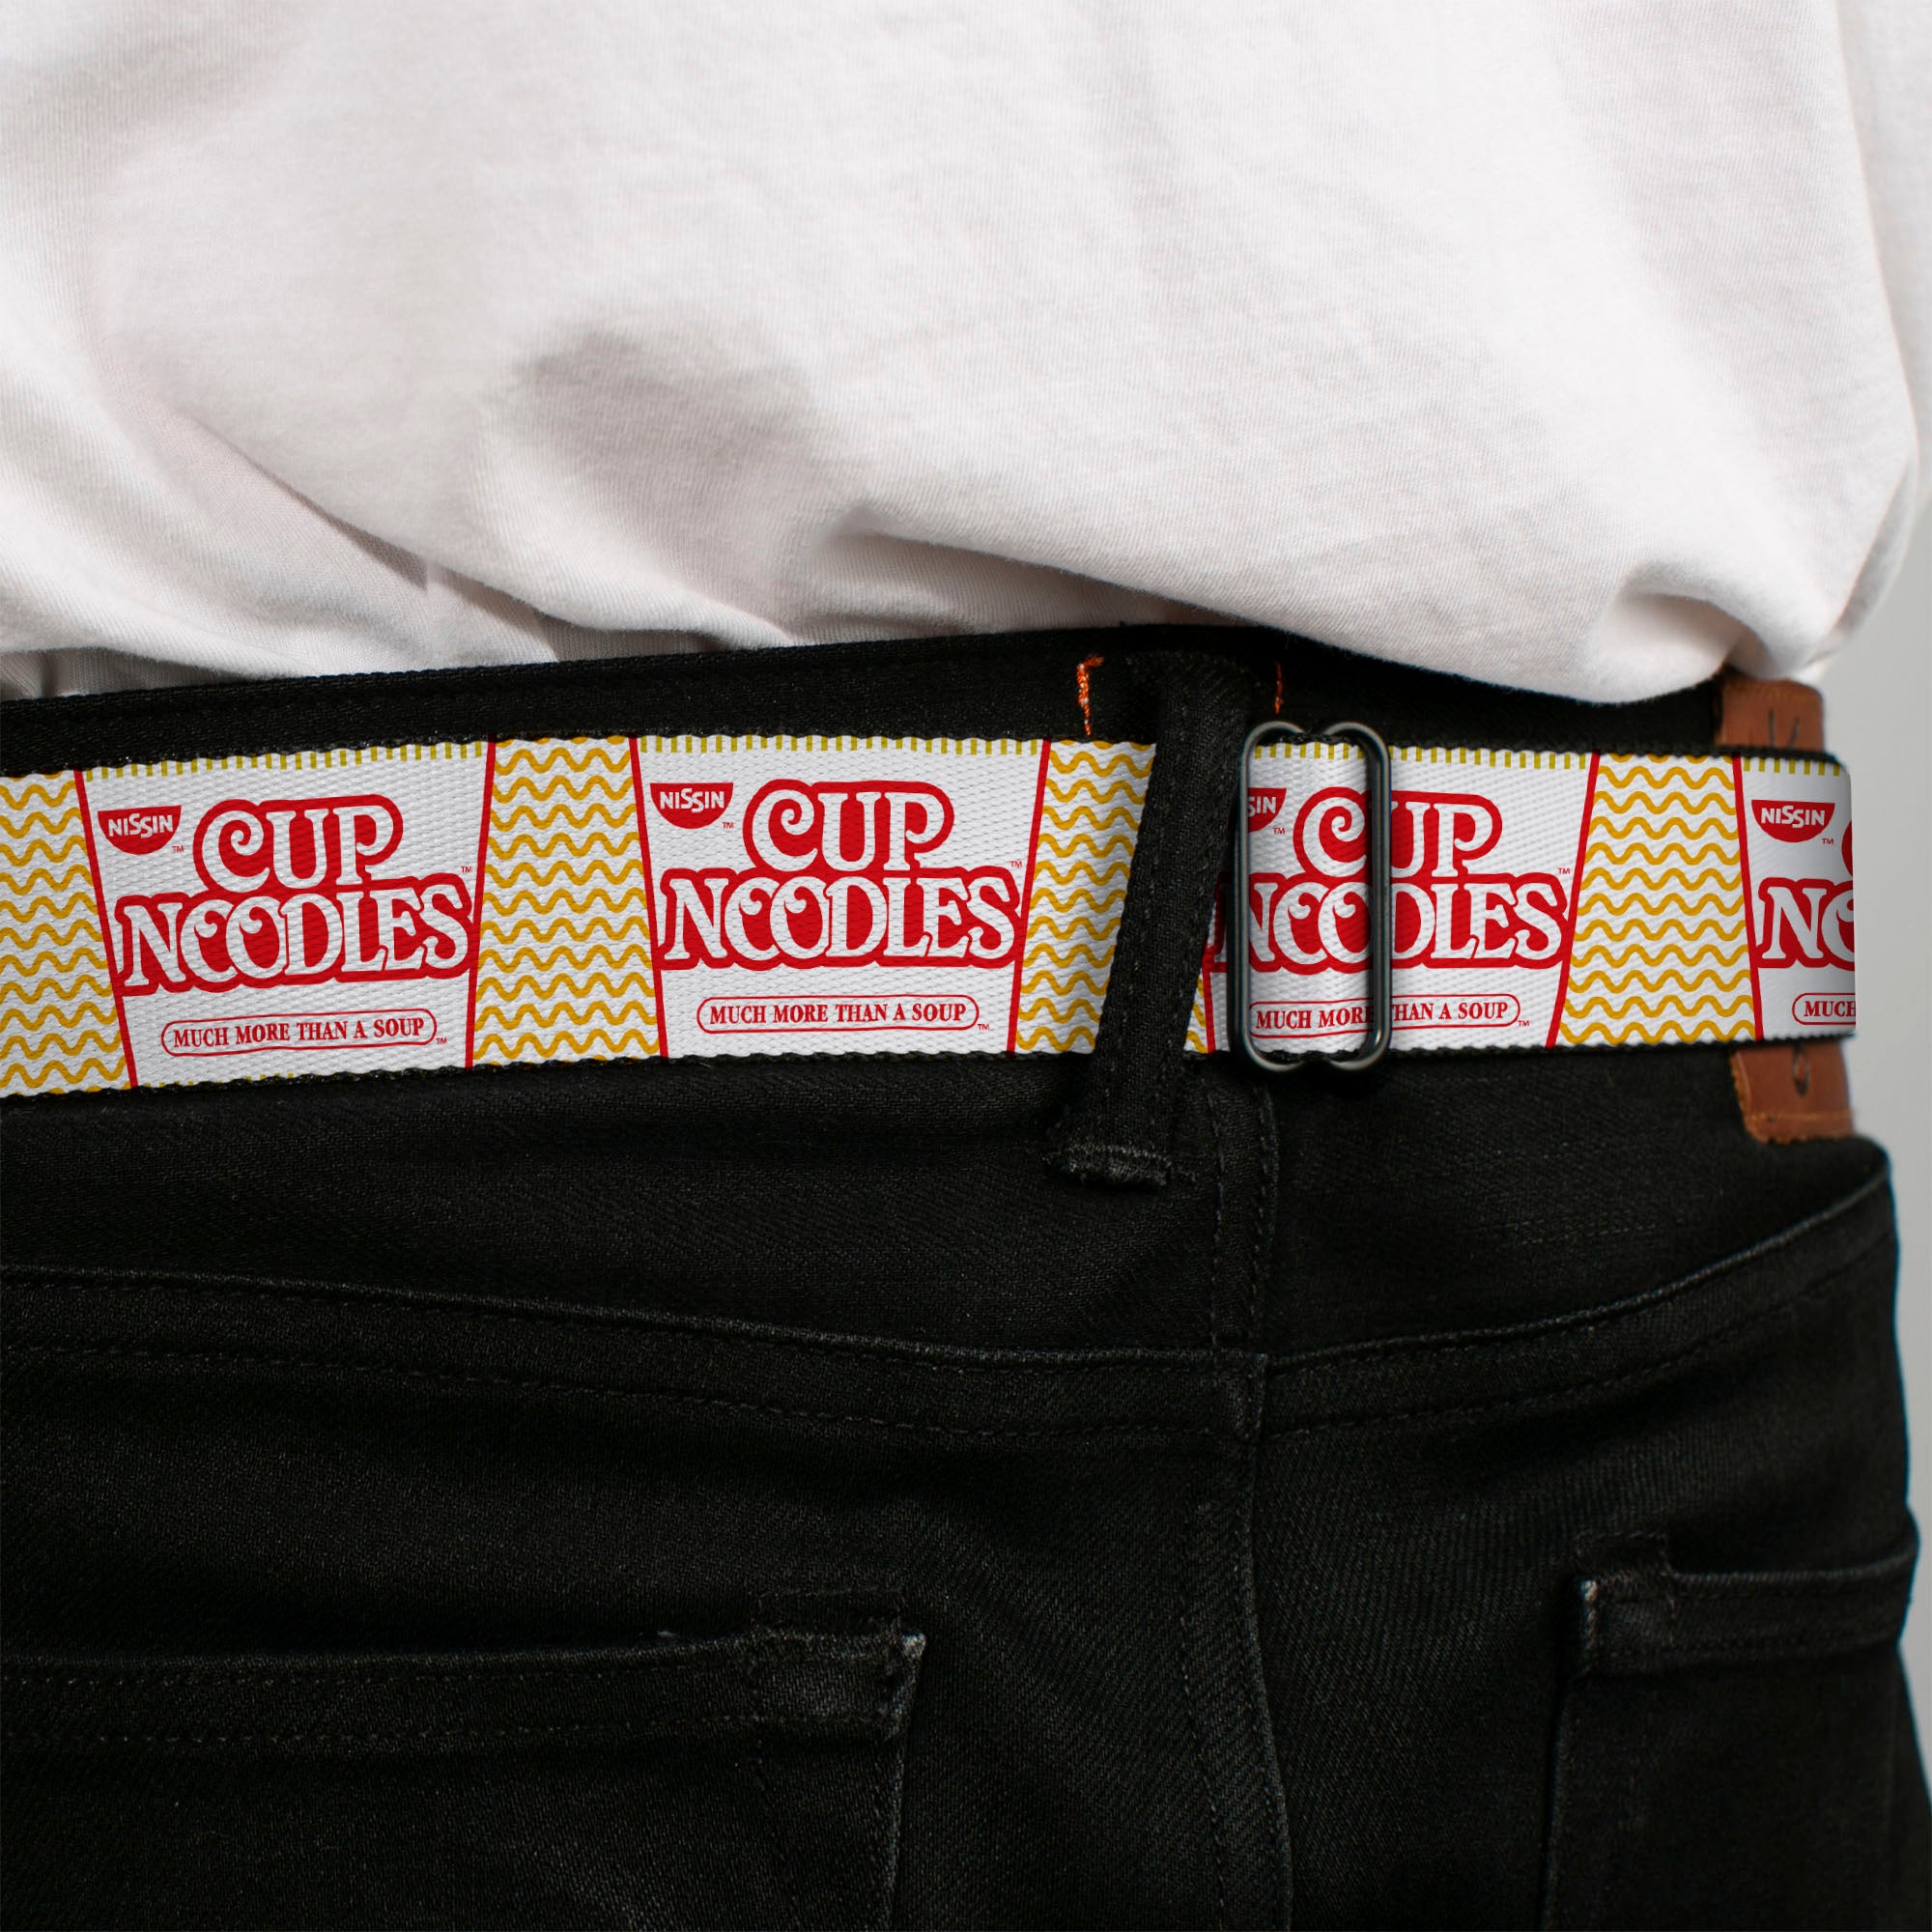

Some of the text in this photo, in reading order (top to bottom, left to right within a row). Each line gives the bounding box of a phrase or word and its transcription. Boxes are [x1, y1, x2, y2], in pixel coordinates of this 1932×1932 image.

[107, 812, 175, 838] NISSIN
[659, 787, 725, 813] NISSIN
[1761, 805, 1826, 828] NISSIN
[201, 804, 397, 893] CUP
[753, 788, 947, 871] CUP
[1302, 796, 1493, 878] CUP
[123, 884, 469, 986] NOODLES
[664, 875, 1016, 961] NOODLES
[1214, 881, 1562, 965] NOODLES
[173, 1026, 228, 1048] MUCH
[235, 1023, 290, 1043] MORE
[296, 1021, 347, 1040] THAN
[354, 1019, 365, 1038] A
[374, 1017, 424, 1037] SOUP
[709, 1005, 766, 1024] MUCH
[773, 1005, 828, 1023] MORE
[835, 1004, 886, 1021] THAN
[893, 1003, 905, 1021] A
[912, 1003, 966, 1021] SOUP
[1256, 1009, 1312, 1030] MUCH
[1438, 1001, 1452, 1020] A
[1459, 999, 1508, 1019] SOUP
